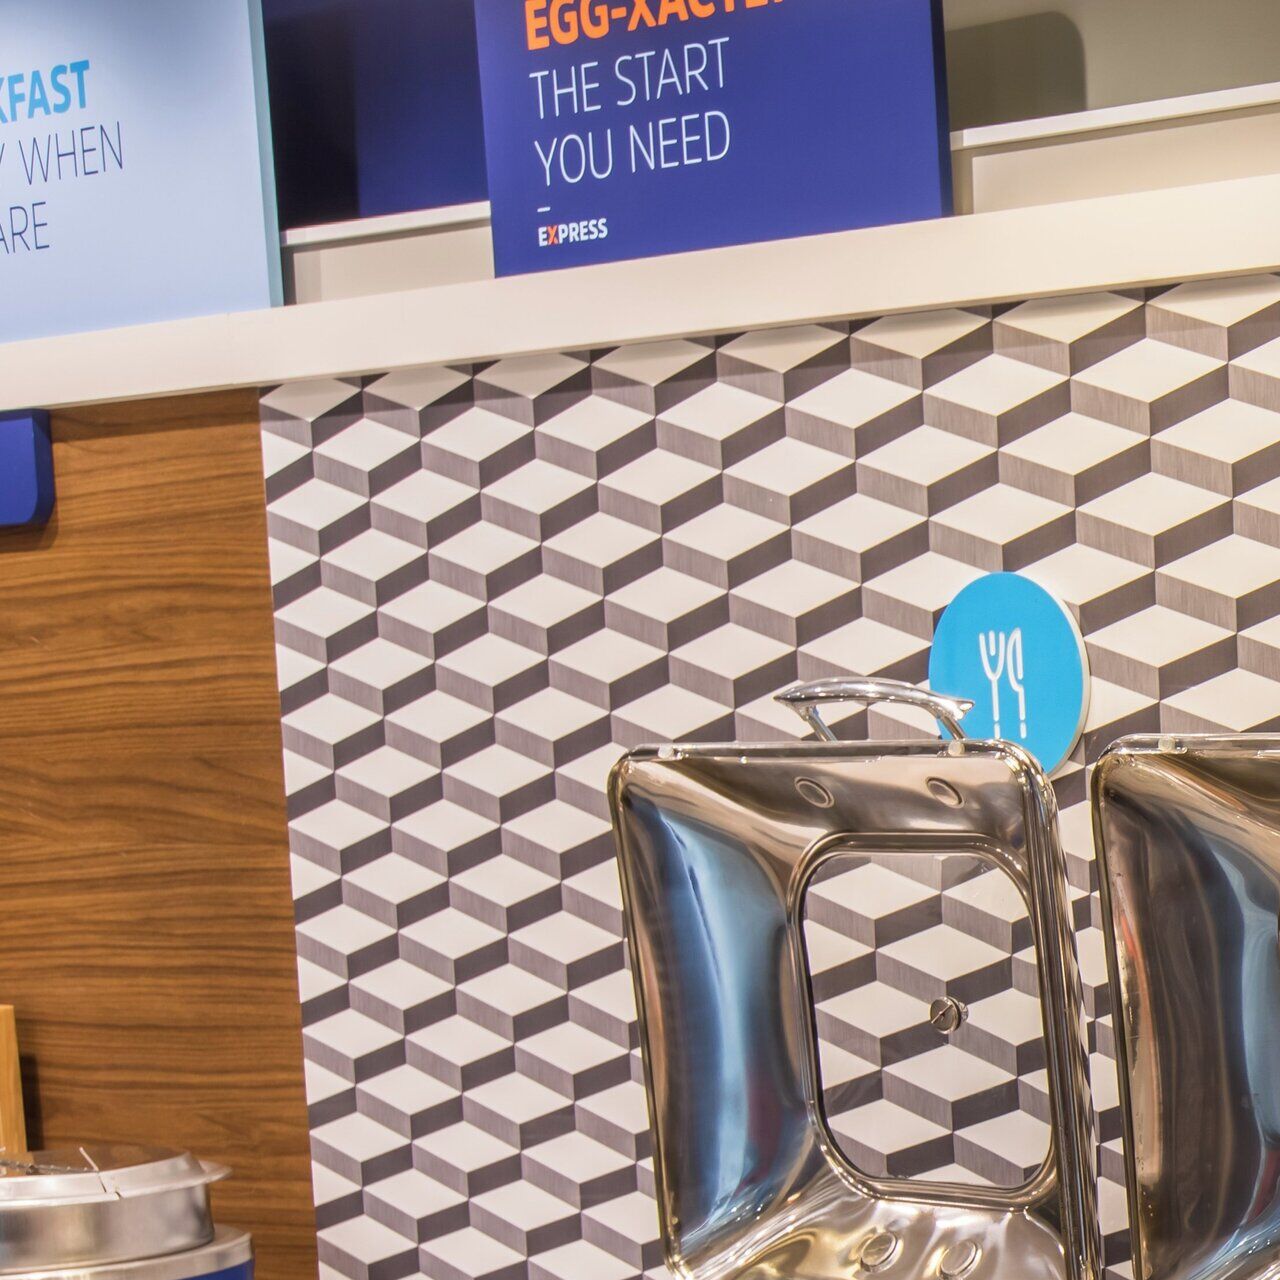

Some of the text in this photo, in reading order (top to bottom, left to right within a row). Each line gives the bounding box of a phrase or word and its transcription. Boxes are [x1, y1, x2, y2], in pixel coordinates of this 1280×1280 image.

[529, 37, 730, 119] THE START
[18, 121, 123, 185] WHEN
[533, 110, 731, 187] YOU NEED
[538, 217, 608, 247] EXPRESS
